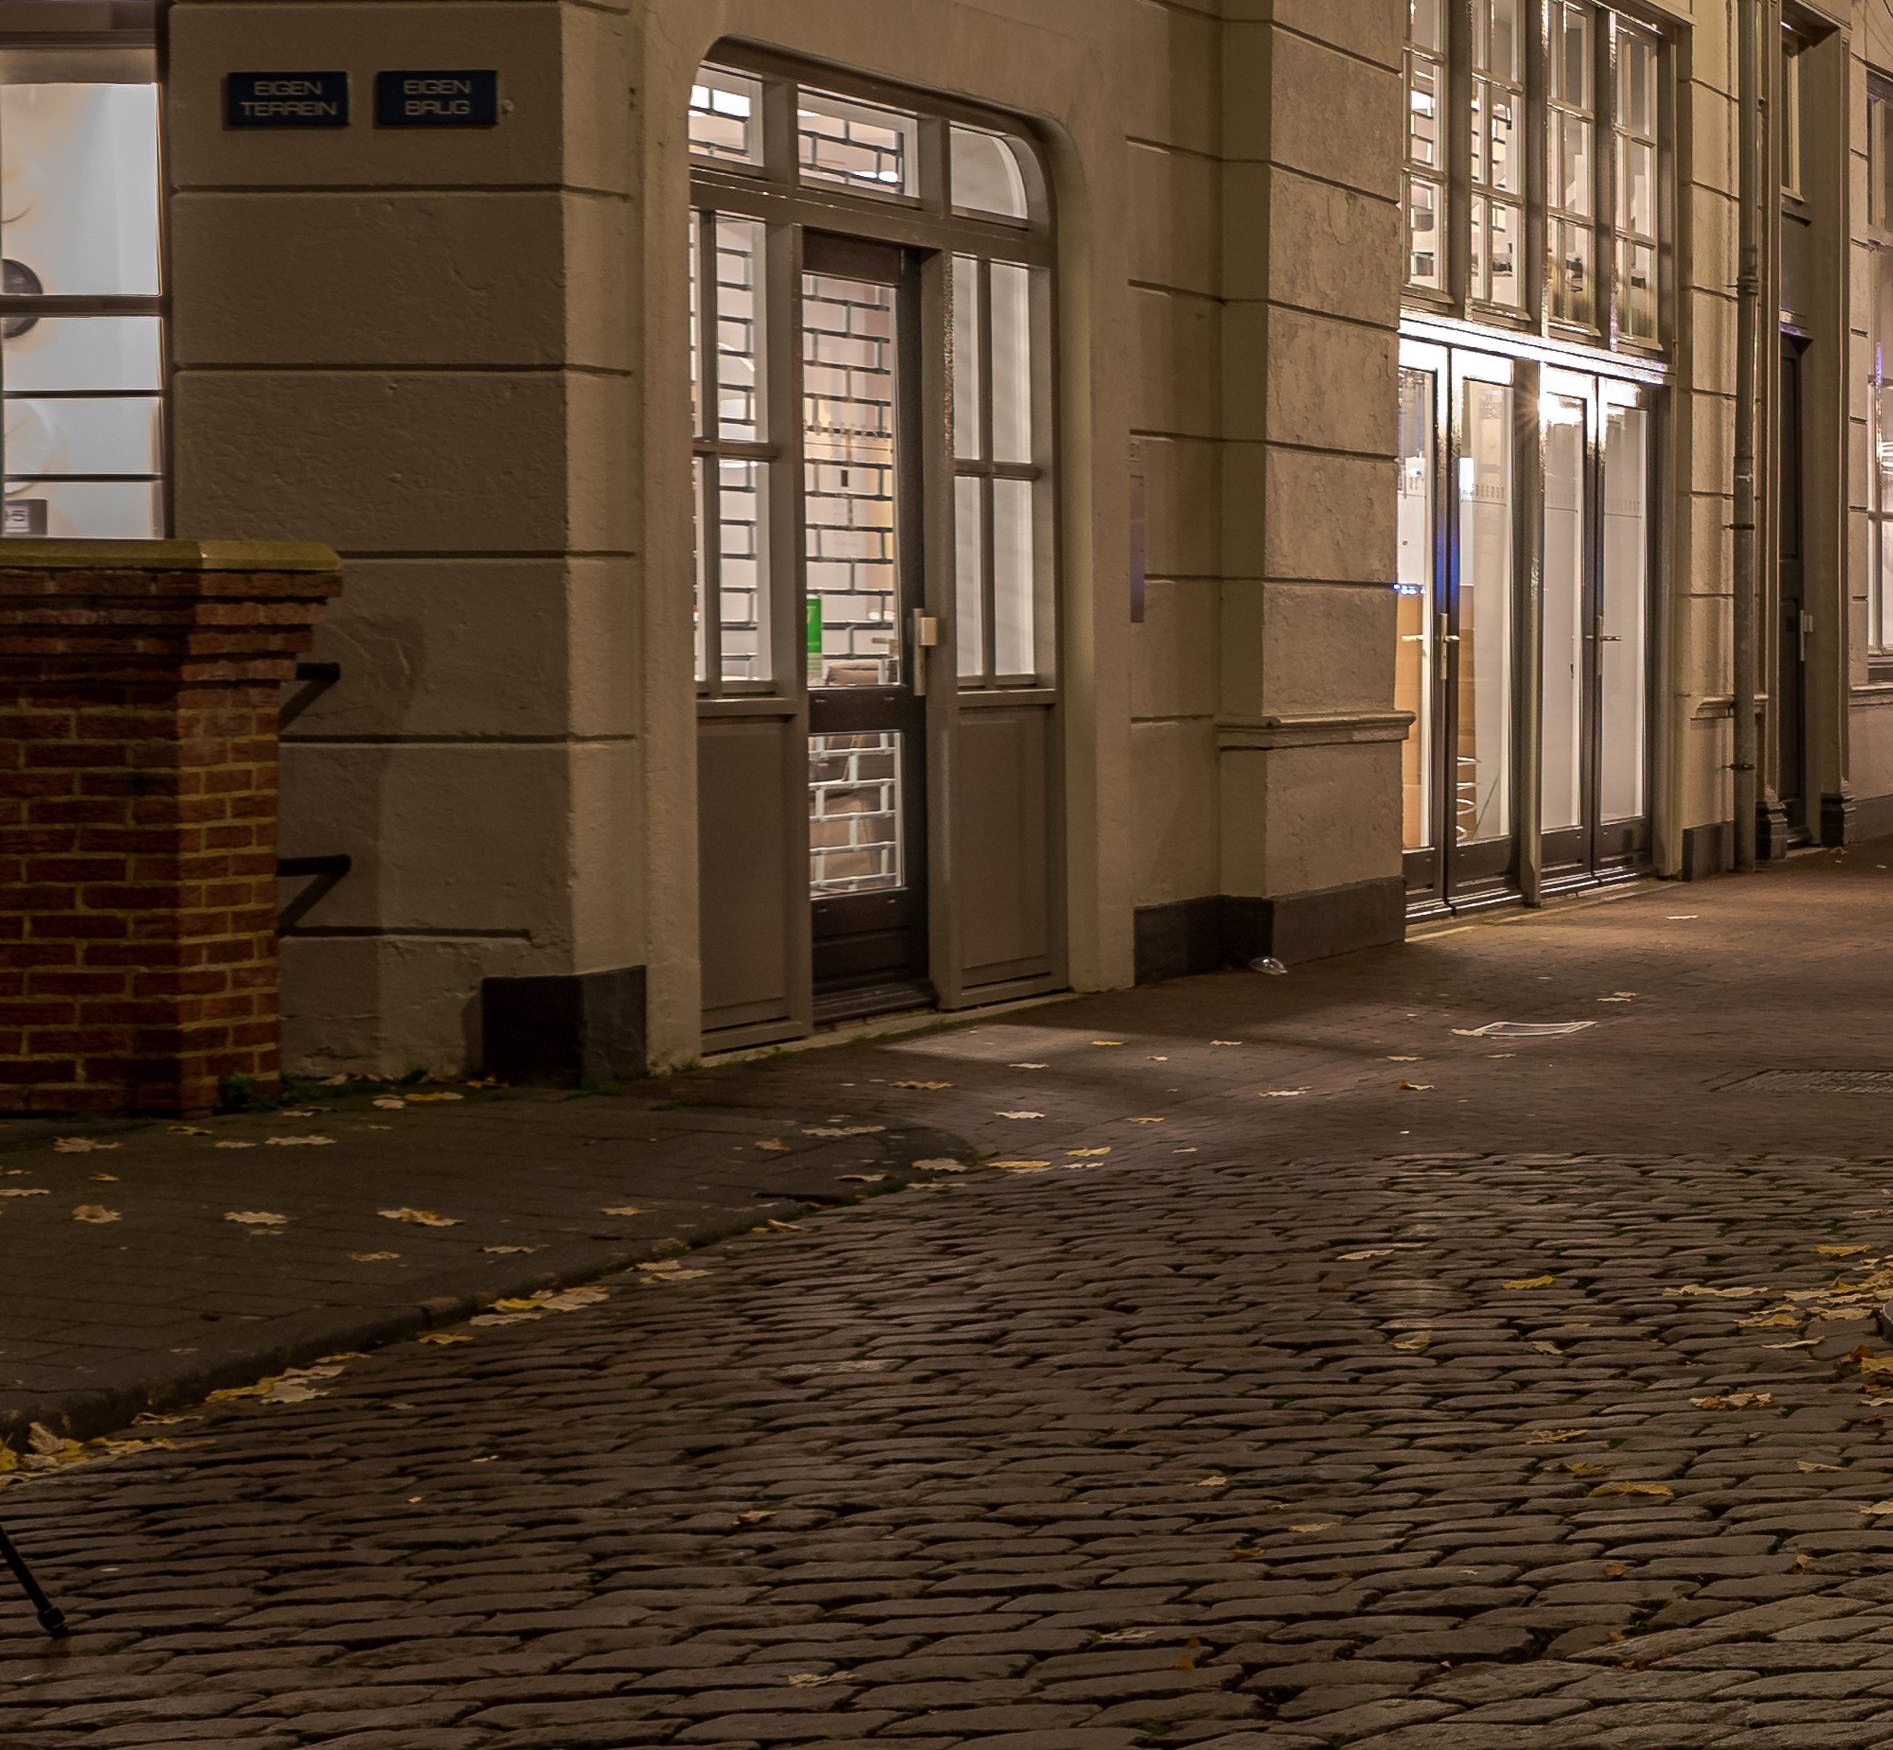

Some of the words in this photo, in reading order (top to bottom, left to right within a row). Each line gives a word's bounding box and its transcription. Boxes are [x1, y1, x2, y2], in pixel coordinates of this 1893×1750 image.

[254, 81, 322, 96] EIGEN
[404, 80, 471, 95] EIGEN
[240, 101, 338, 117] TERREIN
[405, 100, 471, 116] BRUG
